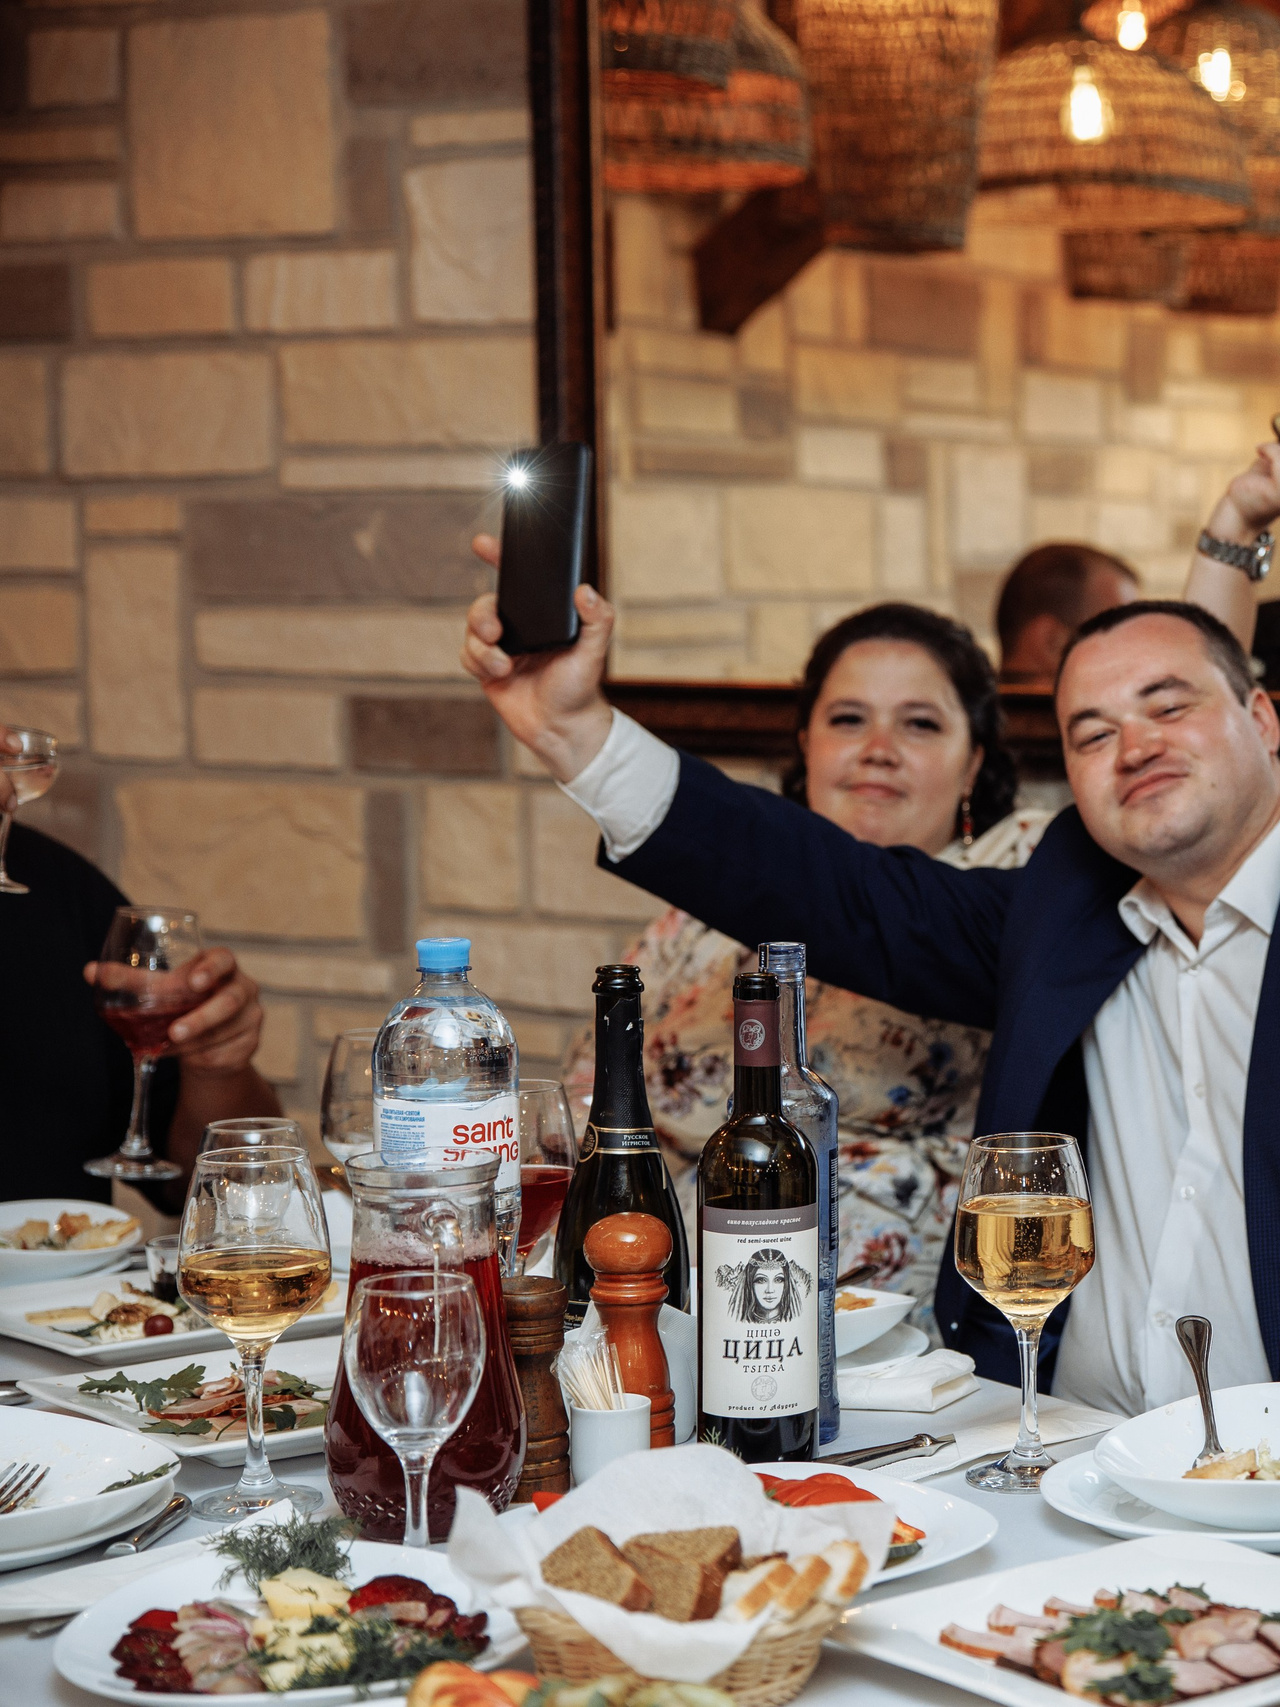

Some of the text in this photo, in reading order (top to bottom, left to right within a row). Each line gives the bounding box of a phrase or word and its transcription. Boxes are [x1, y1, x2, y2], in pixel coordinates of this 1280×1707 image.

[453, 1116, 513, 1145] saint
[722, 1336, 804, 1364] ЦИЦА
[743, 1364, 785, 1373] TSITSA
